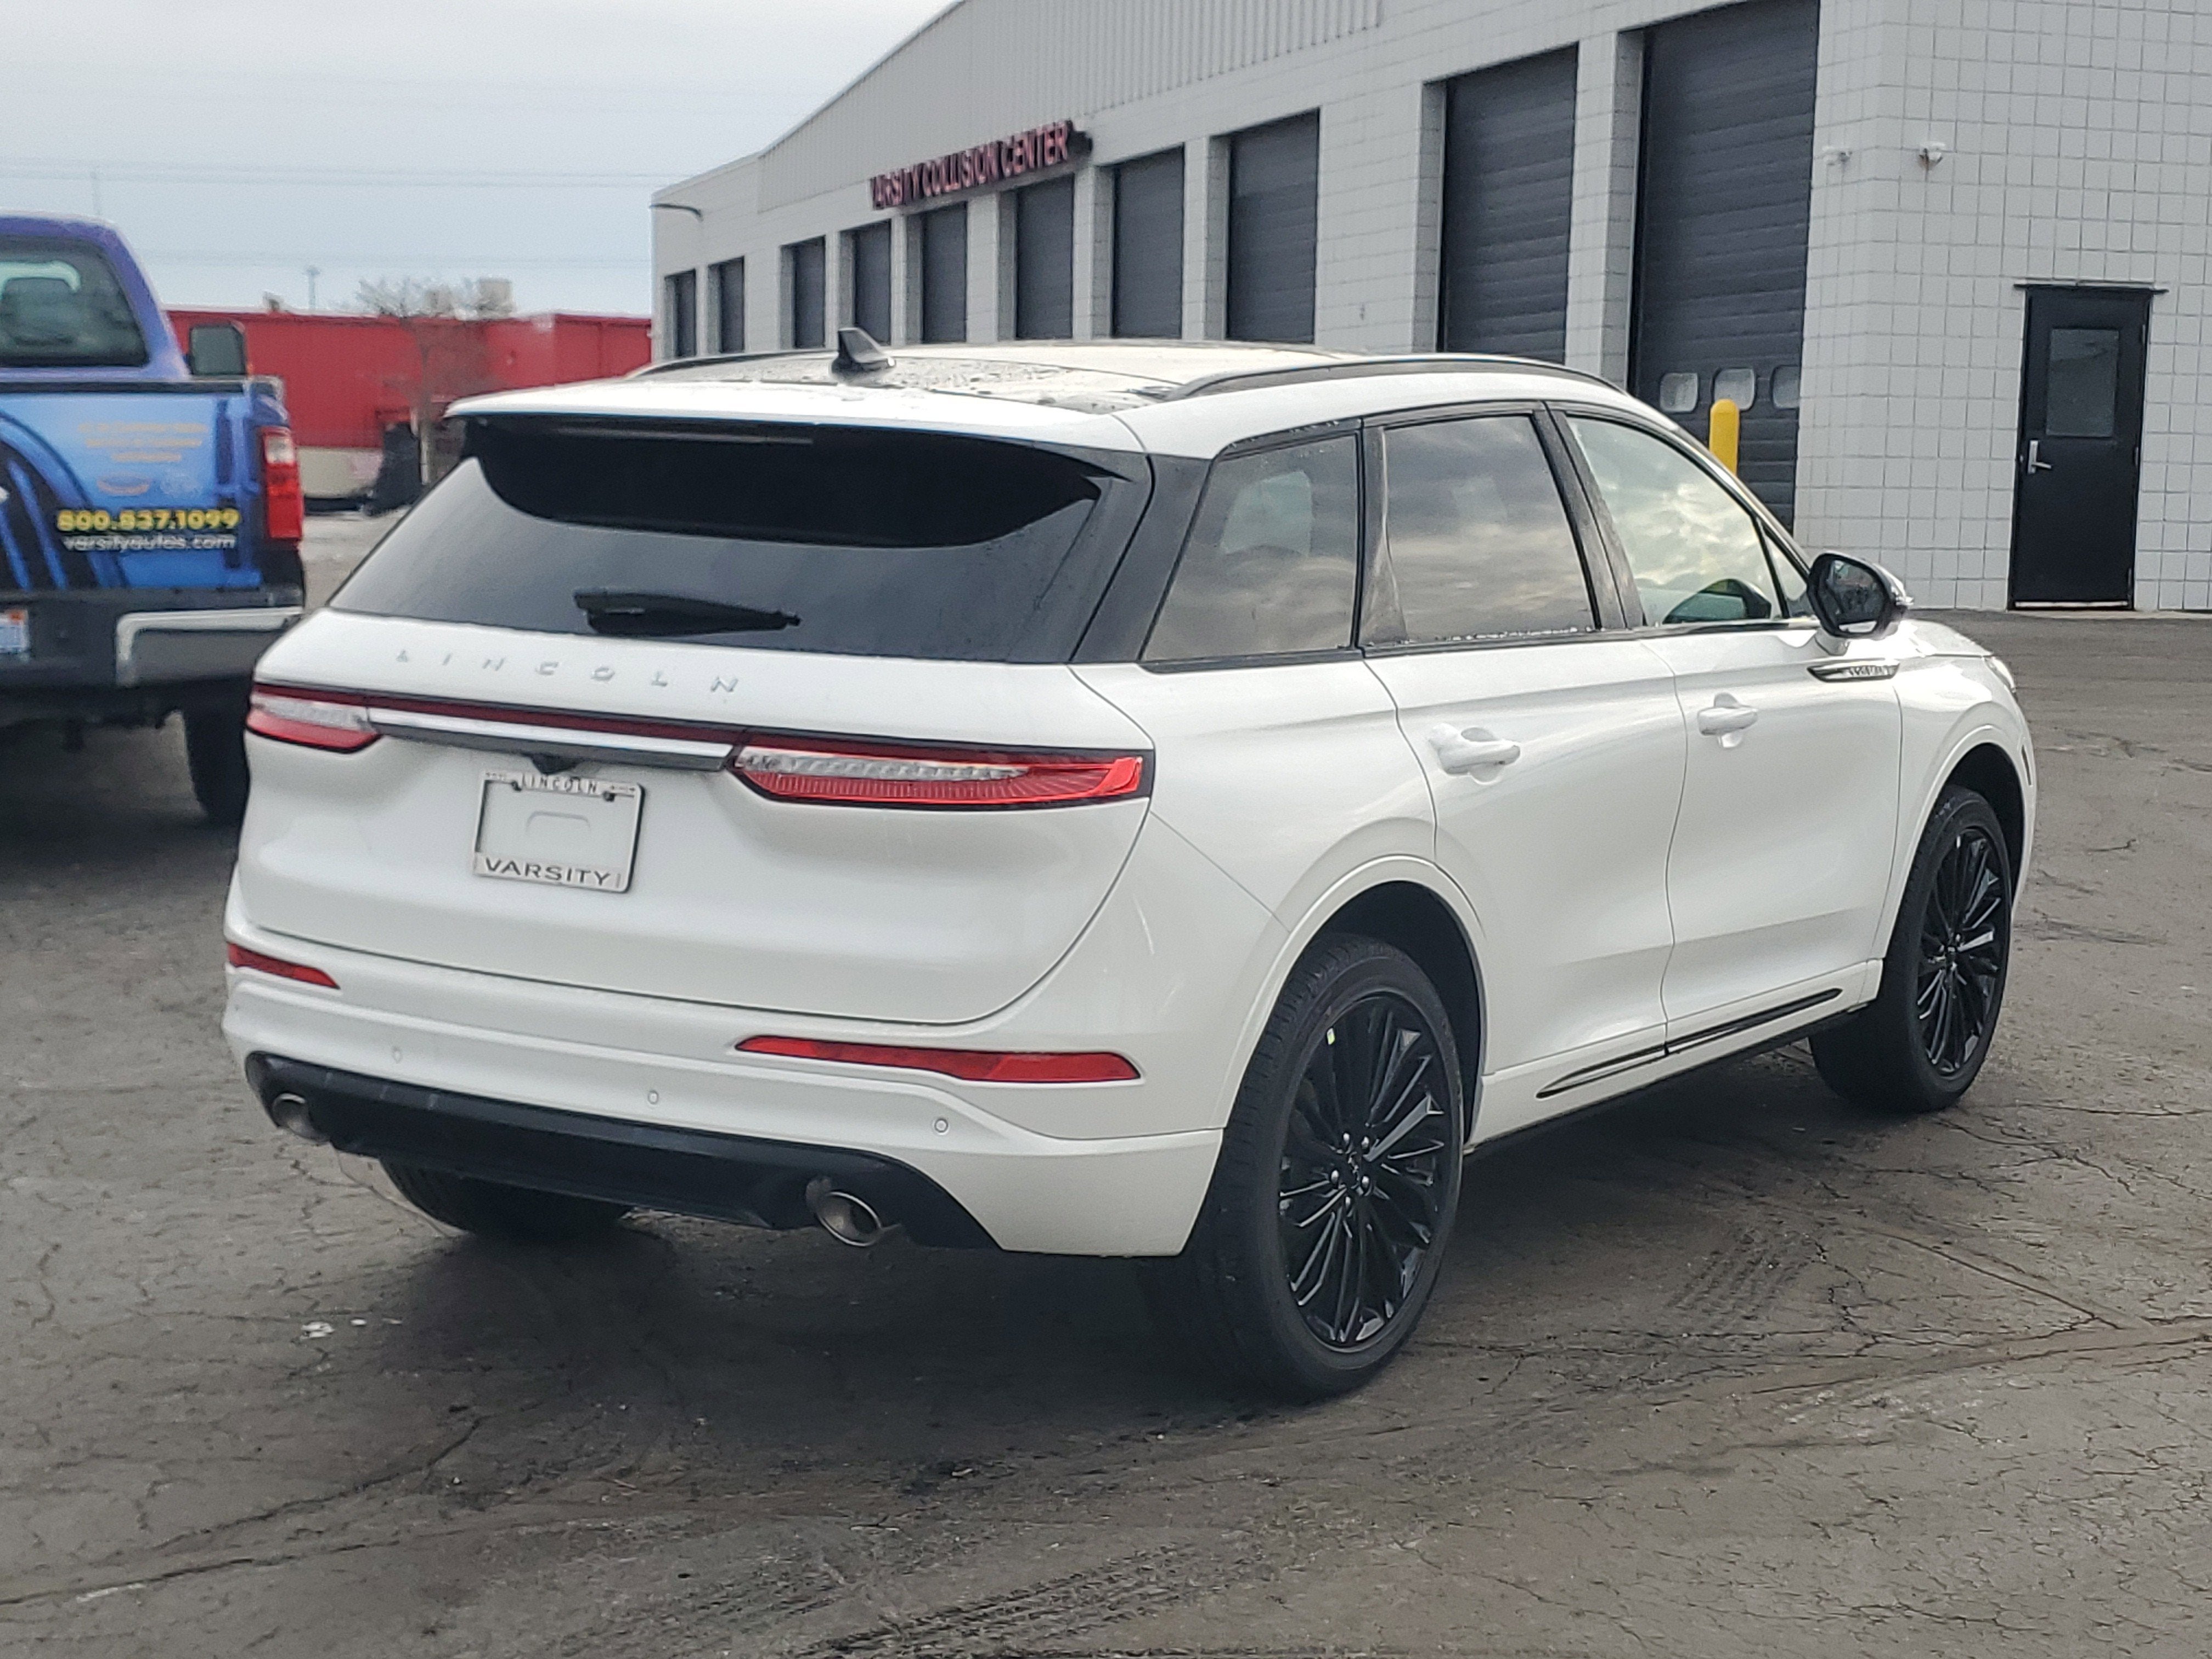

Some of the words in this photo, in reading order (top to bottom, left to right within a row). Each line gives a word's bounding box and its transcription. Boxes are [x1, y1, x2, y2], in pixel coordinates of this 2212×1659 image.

[921, 142, 999, 197] COLLISION
[1001, 120, 1069, 178] CENTER
[396, 650, 740, 693] LINCOLN
[521, 774, 598, 793] LINCOLN
[485, 857, 611, 886] VARSITY
